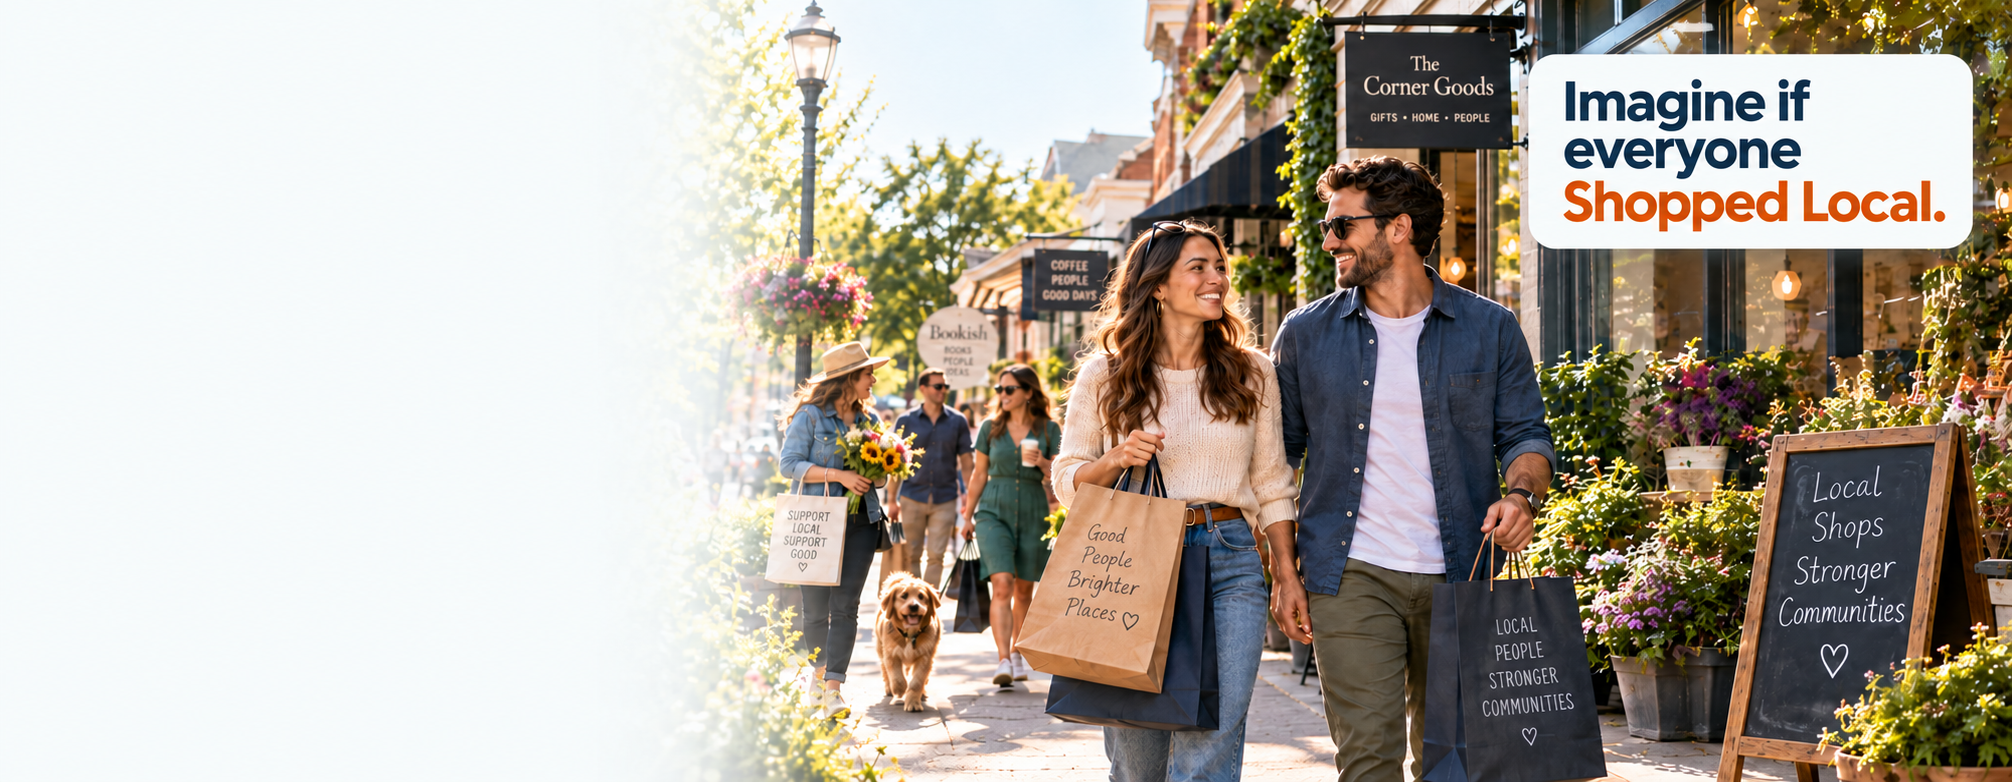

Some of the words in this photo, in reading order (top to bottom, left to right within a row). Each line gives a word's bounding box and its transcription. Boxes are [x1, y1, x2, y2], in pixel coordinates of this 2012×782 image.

[1409, 55, 1440, 71] The
[1363, 75, 1430, 96] Corner
[1433, 75, 1495, 96] Goods
[1370, 112, 1398, 123] GIFTS
[1411, 112, 1440, 123] HOME
[1454, 113, 1490, 123] PEOPLE
[1050, 259, 1089, 272] COFFEE
[1051, 274, 1089, 286] PEOPLE
[1042, 289, 1070, 301] GOOD
[1072, 289, 1098, 301] DAYS
[930, 324, 987, 341] Bookish
[944, 346, 972, 355] BOOKS
[943, 357, 973, 366] PEOPLE
[1813, 465, 1882, 503] Local
[787, 510, 830, 522] SUPPORT
[792, 522, 822, 535] LOCAL
[1087, 523, 1127, 545] Good
[1812, 511, 1884, 549] Shops
[783, 535, 827, 547] SUPPORT
[790, 548, 818, 560] GOOD
[1083, 545, 1133, 571] People
[1067, 569, 1141, 597] Brighter
[1793, 556, 1897, 594] Stronger
[1064, 597, 1117, 622] Places
[1778, 595, 1906, 627] Communities
[1495, 616, 1538, 635] LOCAL
[1494, 640, 1545, 662] PEOPLE
[1488, 667, 1559, 689] STRONGER
[1482, 692, 1575, 718] COMMUNITIES
